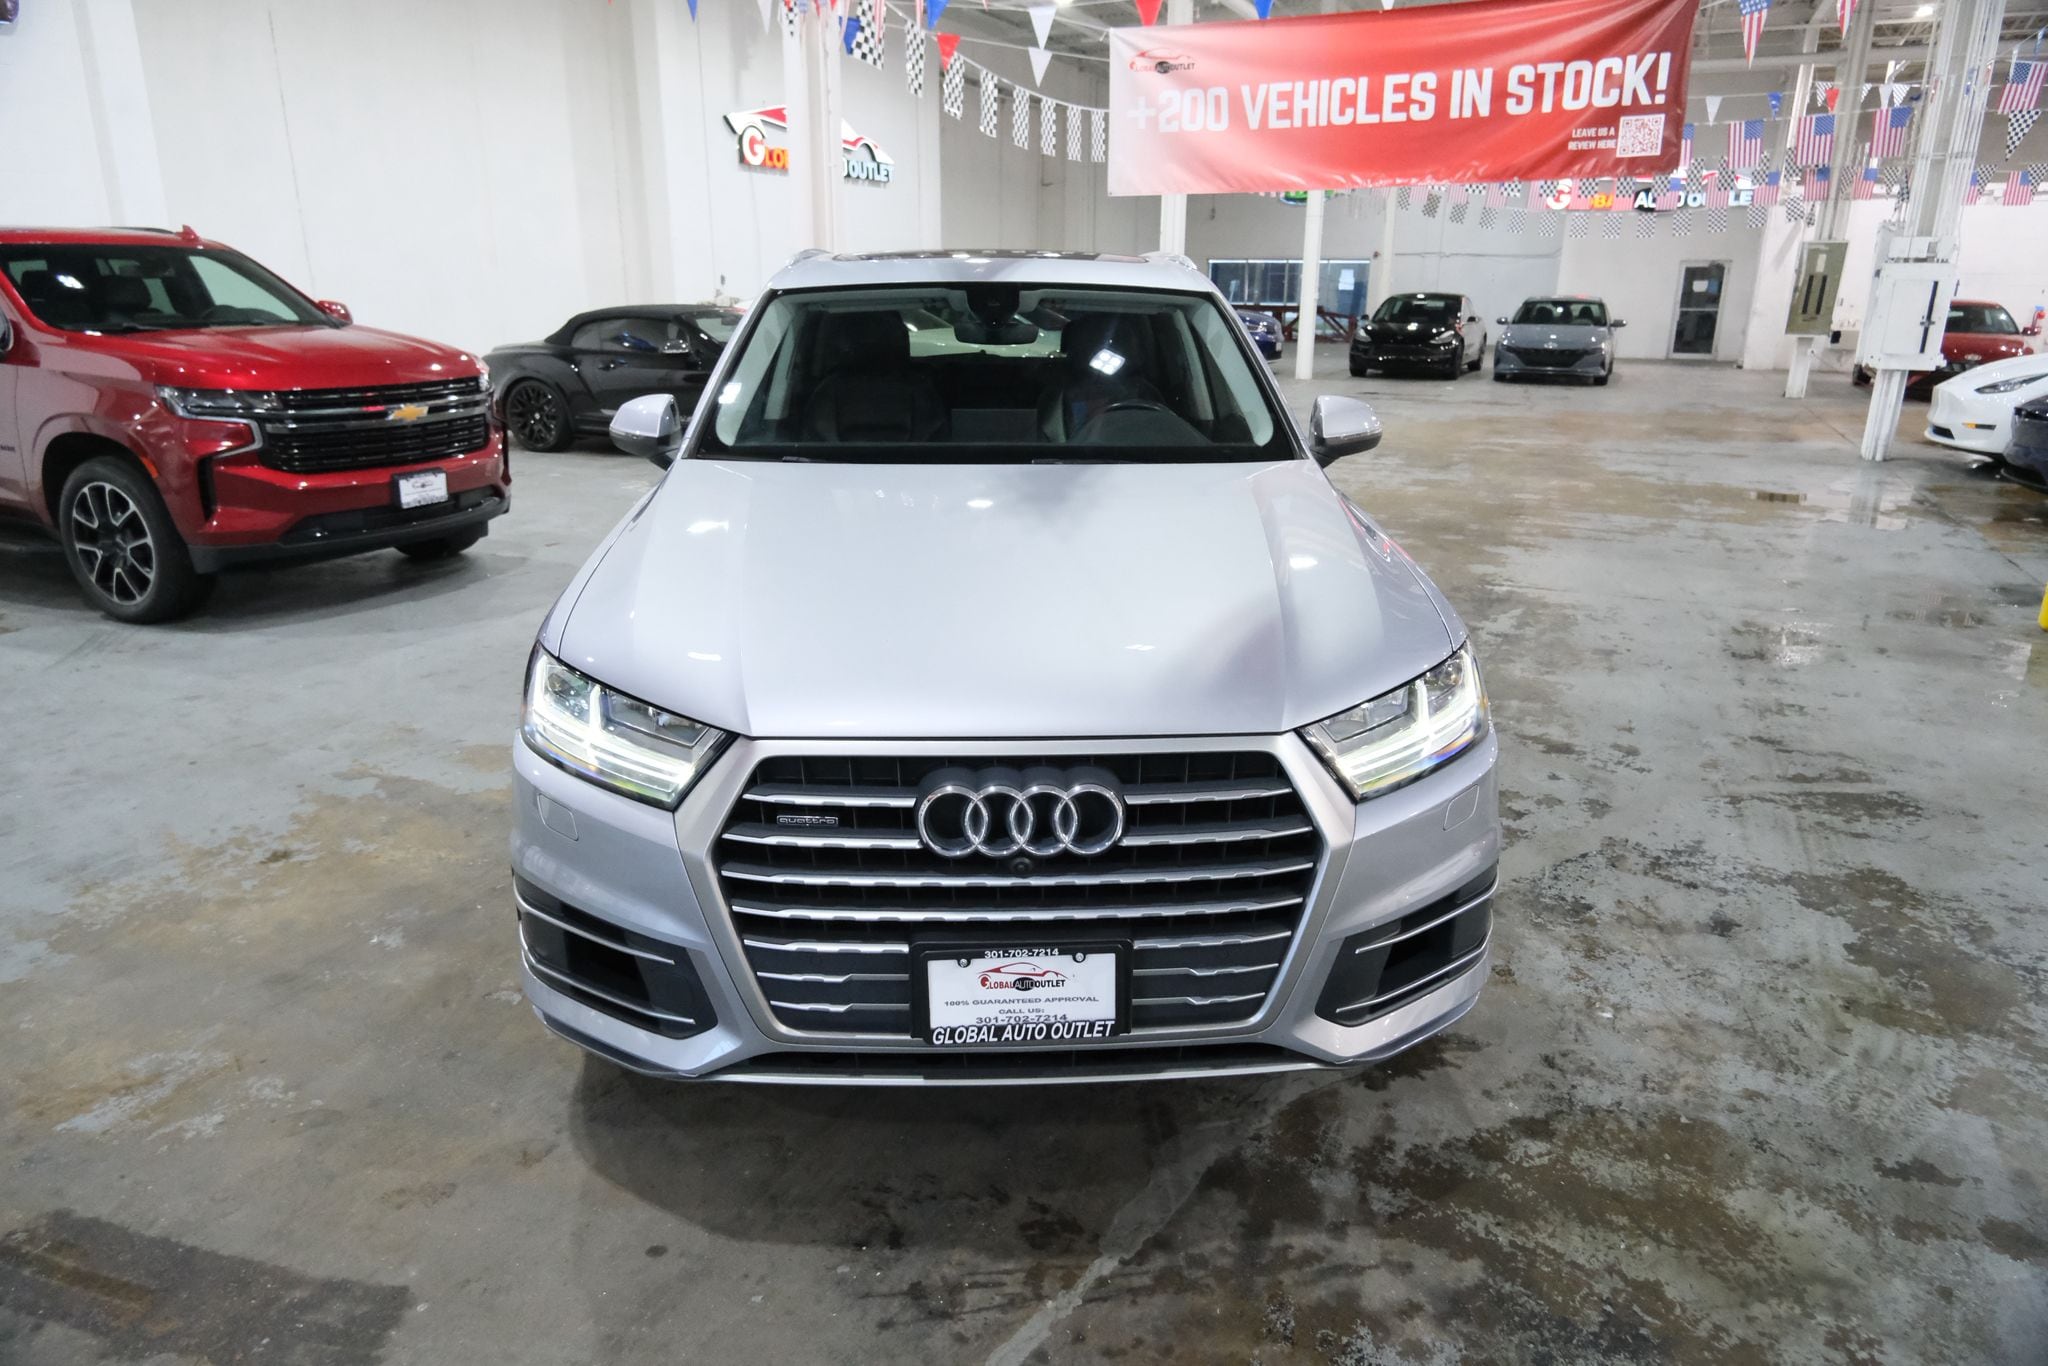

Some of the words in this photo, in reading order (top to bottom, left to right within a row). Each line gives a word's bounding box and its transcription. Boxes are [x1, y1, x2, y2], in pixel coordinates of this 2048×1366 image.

[1127, 87, 1229, 133] +200
[1241, 72, 1437, 130] VEHICLES
[1449, 68, 1493, 119] IN
[1505, 52, 1671, 115] STOCK!
[1571, 128, 1596, 138] LEAVE
[1597, 127, 1608, 137] US
[1609, 126, 1615, 136] A
[1567, 140, 1596, 150] REVIEW
[1597, 138, 1617, 149] HERE
[779, 817, 835, 825] quattro
[984, 948, 1059, 959] 301-702-7214
[980, 976, 1014, 990] GLOBAL
[1035, 979, 1066, 988] OUTLET
[972, 998, 1042, 1006] GUARANTEED
[976, 1014, 1068, 1024] 301-702-7214
[932, 1025, 999, 1045] GLOBAL
[1001, 1022, 1047, 1041] AUTO
[1051, 1020, 1116, 1039] OUTLET
